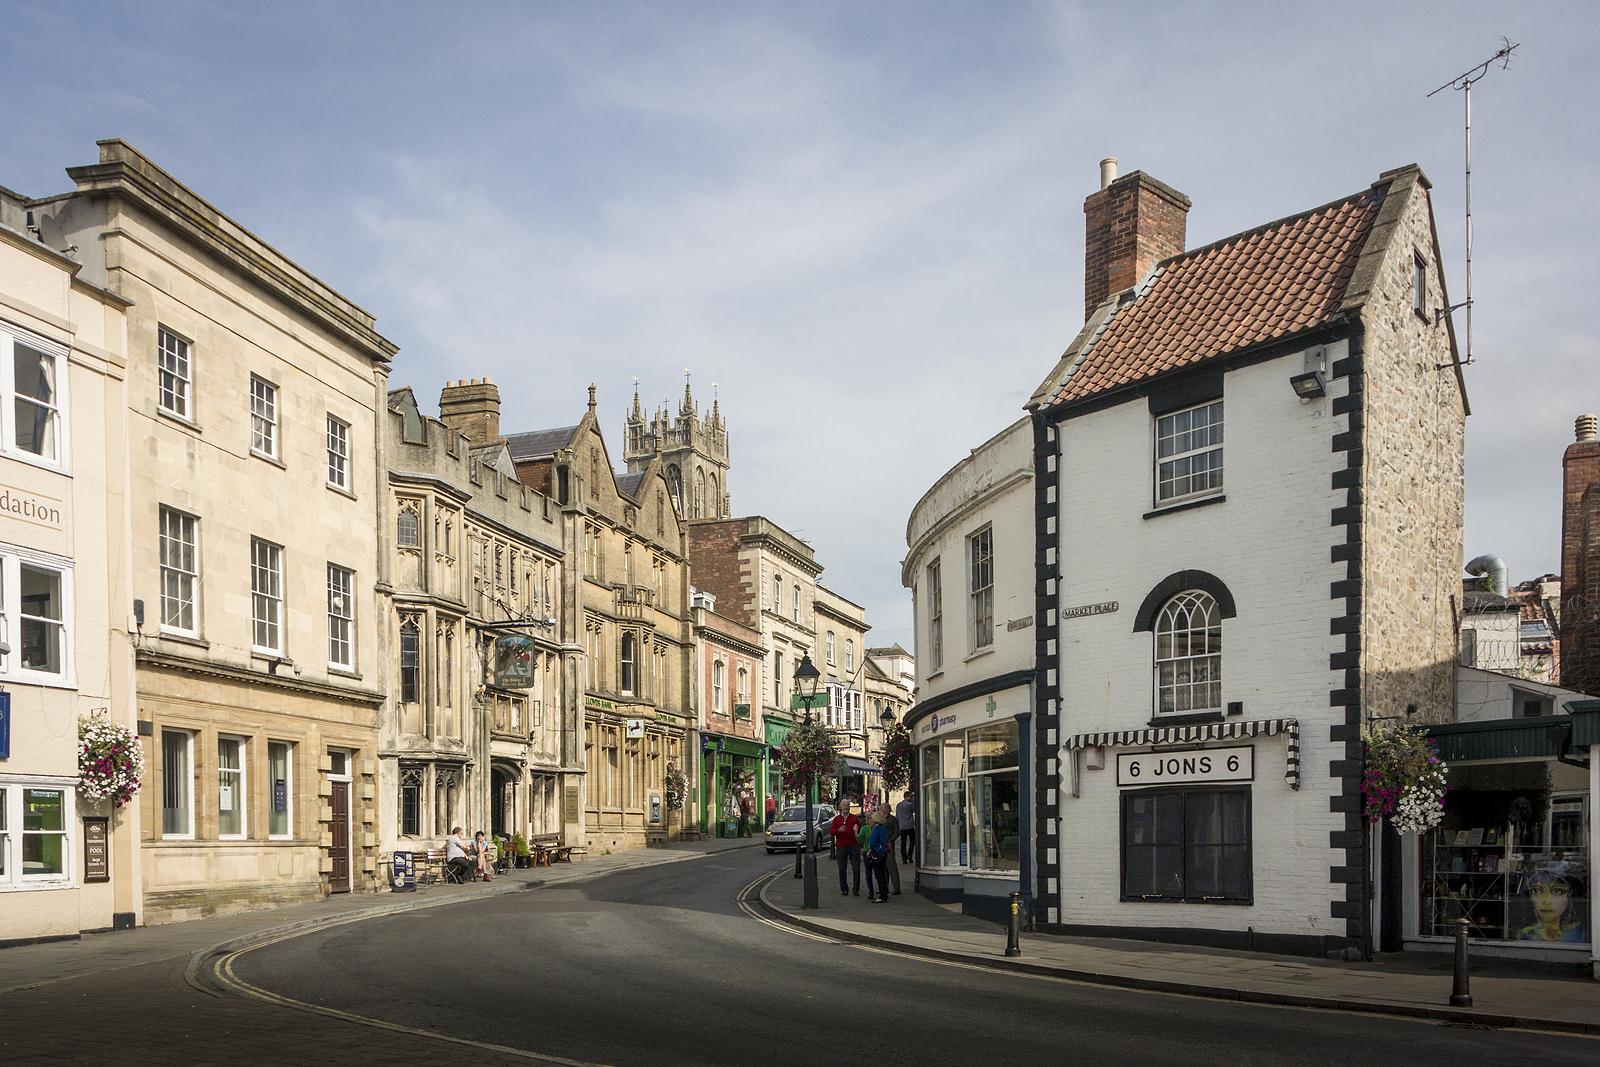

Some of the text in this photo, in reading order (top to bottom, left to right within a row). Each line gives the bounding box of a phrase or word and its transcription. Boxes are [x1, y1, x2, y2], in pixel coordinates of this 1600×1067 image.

[0, 490, 60, 524] dation
[1064, 602, 1117, 617] MARKET PLACE
[939, 714, 957, 728] pharmacy
[1129, 755, 1240, 777] 6 JONS 6
